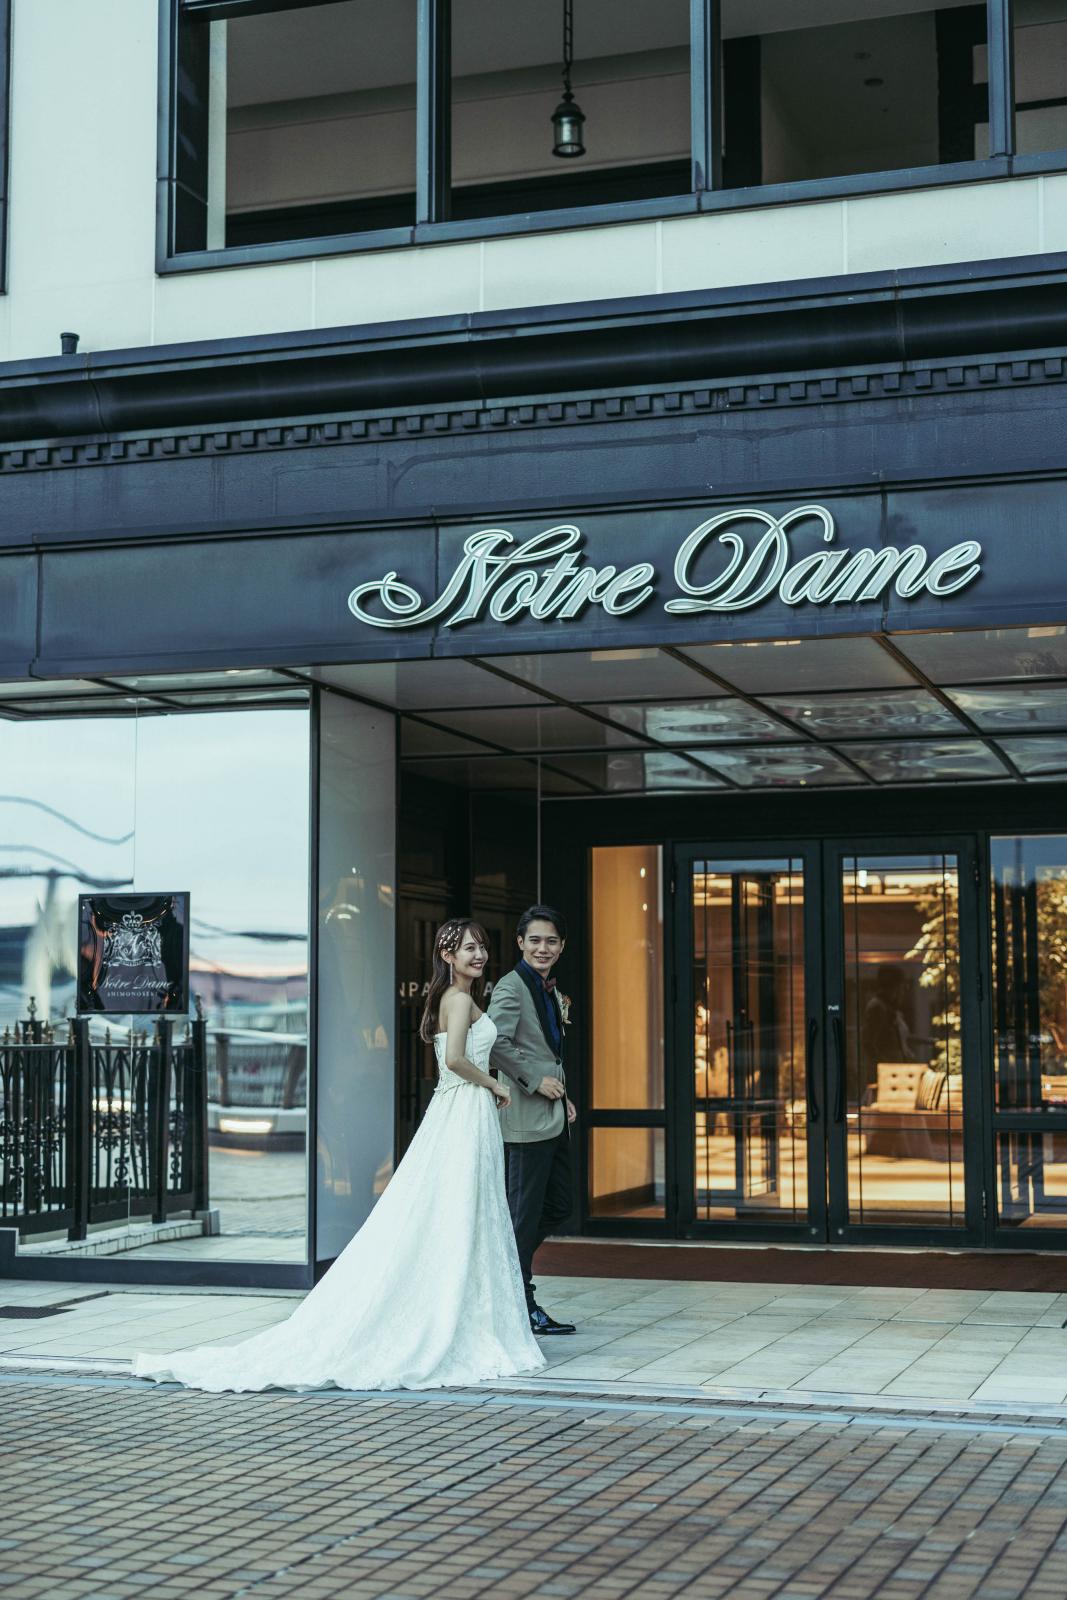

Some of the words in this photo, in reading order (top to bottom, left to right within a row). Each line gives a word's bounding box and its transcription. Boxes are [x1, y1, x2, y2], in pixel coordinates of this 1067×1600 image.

[348, 525, 655, 629] Notre
[664, 504, 982, 614] Dame
[101, 975, 130, 989] Notre
[133, 975, 174, 990] Dame
